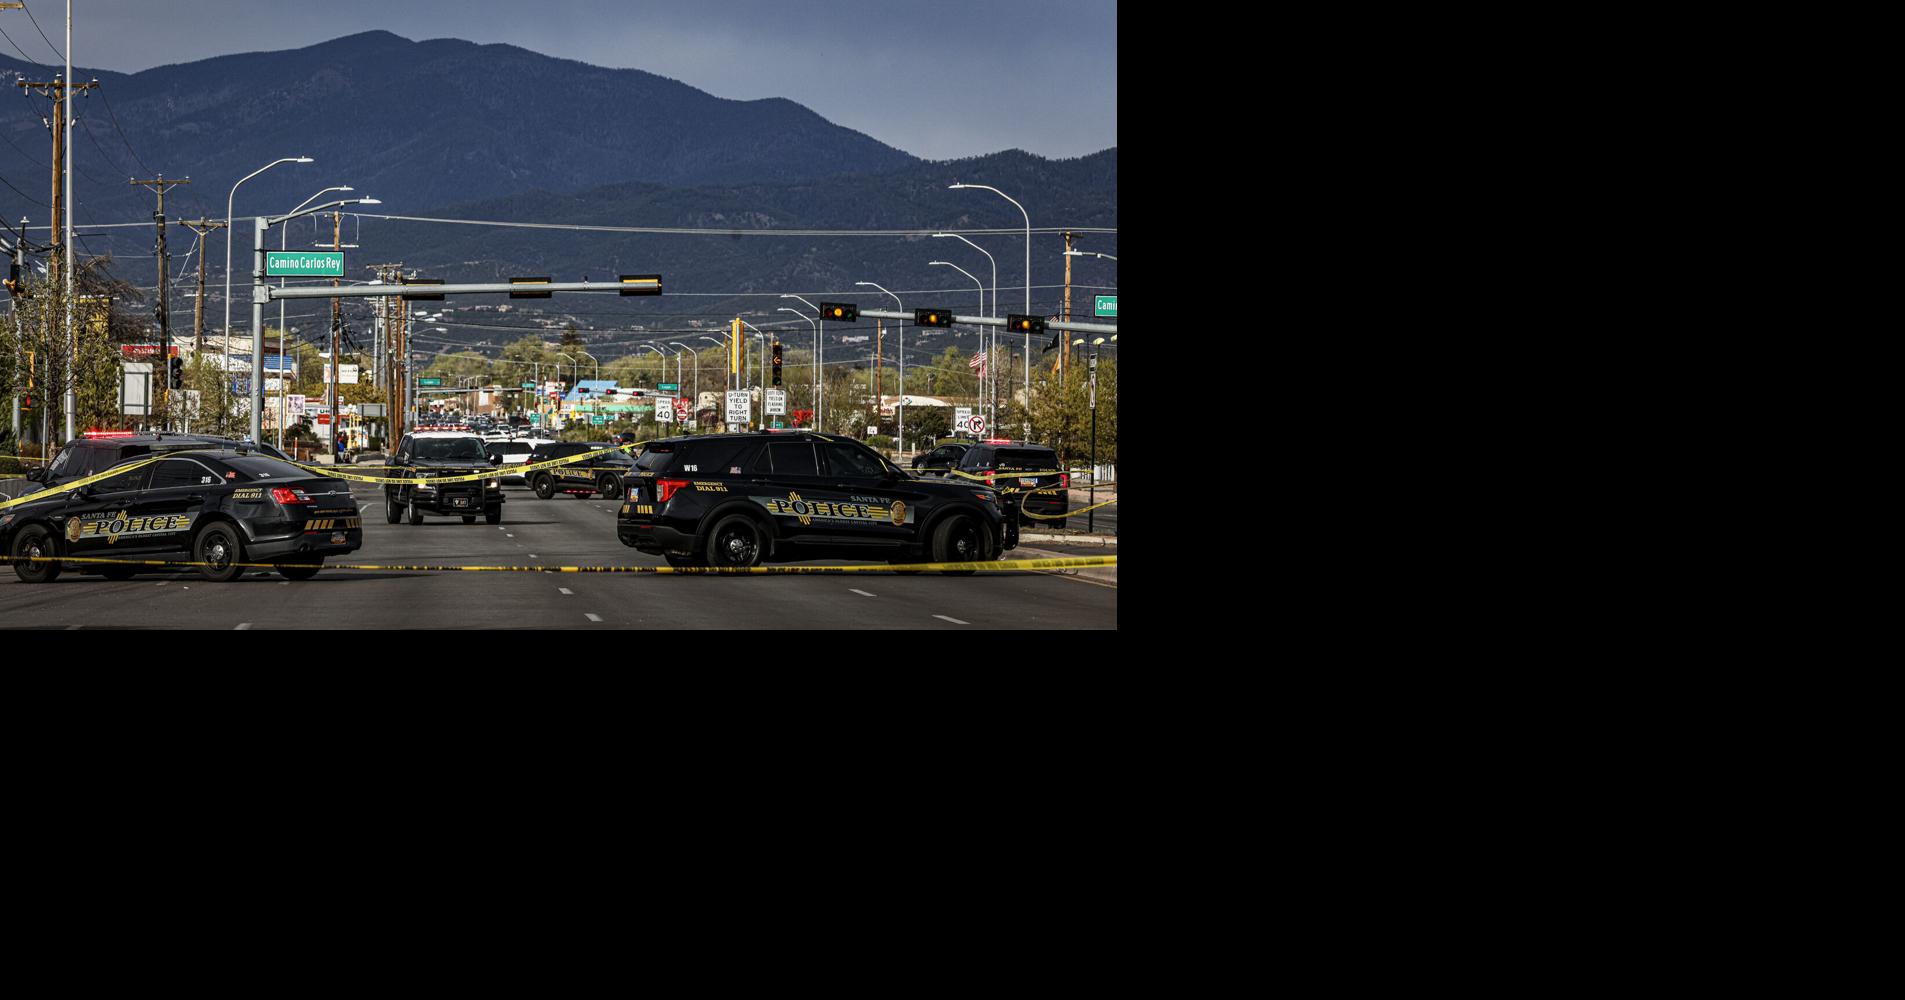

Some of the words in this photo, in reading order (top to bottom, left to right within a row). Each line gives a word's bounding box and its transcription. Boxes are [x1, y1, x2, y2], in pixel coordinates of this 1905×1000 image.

[269, 256, 299, 269] Camino
[300, 256, 325, 269] Carlos
[326, 256, 341, 272] Rey
[657, 411, 670, 419] 40
[553, 468, 582, 477] POLICE
[850, 495, 879, 503] SANTA
[771, 498, 873, 519] POLICE
[81, 511, 106, 520] SANTA
[94, 514, 180, 535] POLICE
